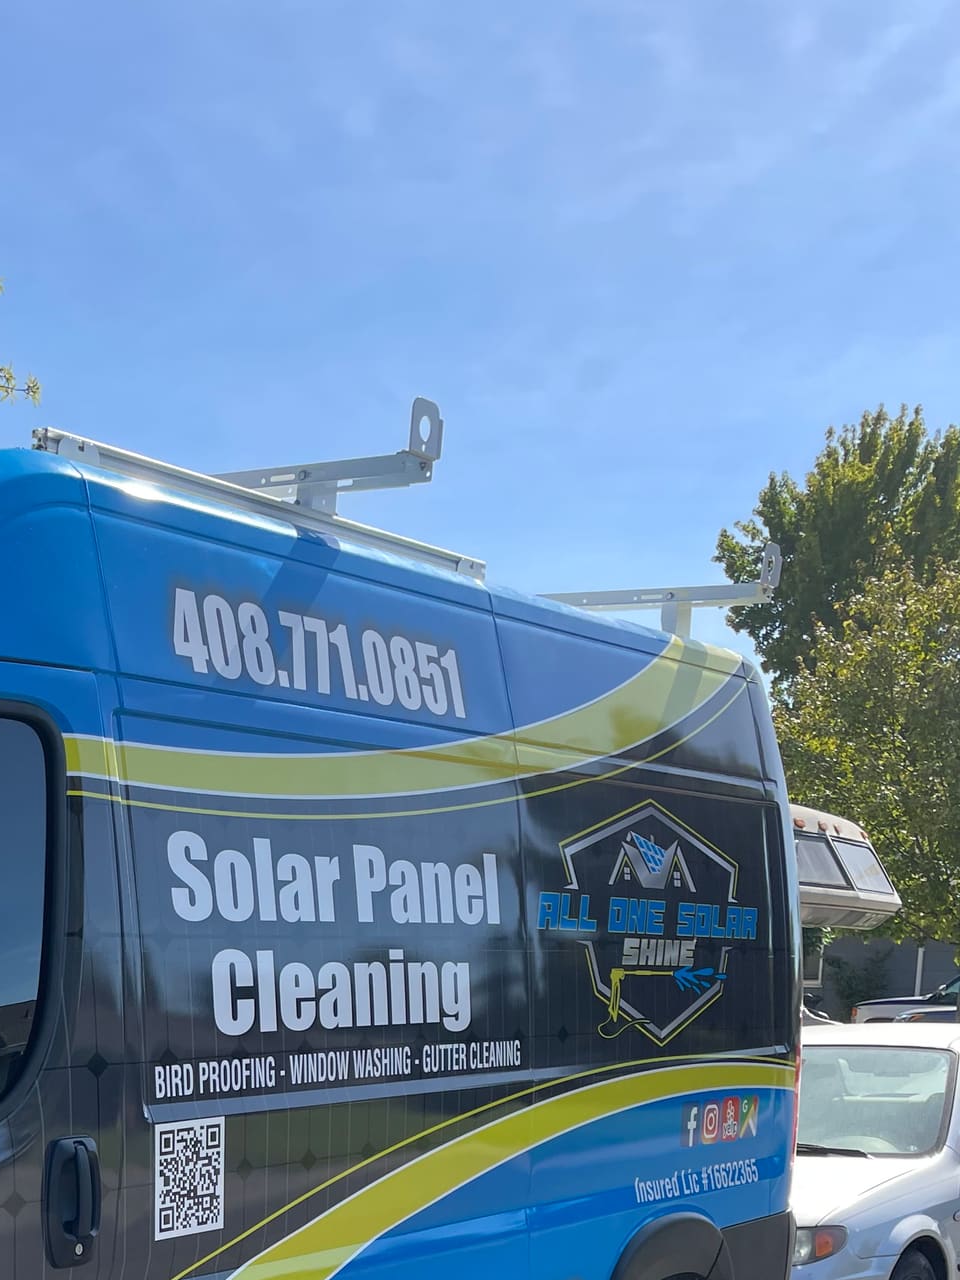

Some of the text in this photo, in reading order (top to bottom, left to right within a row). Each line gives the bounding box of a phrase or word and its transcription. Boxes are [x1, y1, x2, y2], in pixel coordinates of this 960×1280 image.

[173, 588, 467, 719] 408.771.0851
[167, 830, 501, 926] Solar Panel
[537, 891, 758, 940] ALL ONE SOLAR
[621, 937, 697, 967] SHINE
[211, 948, 472, 1037] Cleaning
[154, 1063, 194, 1099] BIRD
[198, 1055, 276, 1093] PROOFING
[289, 1050, 350, 1085] WINDOW
[353, 1046, 412, 1080] WASHING
[423, 1043, 468, 1073] GUTTER
[470, 1039, 522, 1069] CLEANING
[634, 1158, 759, 1204] Insured Lic #16622365
